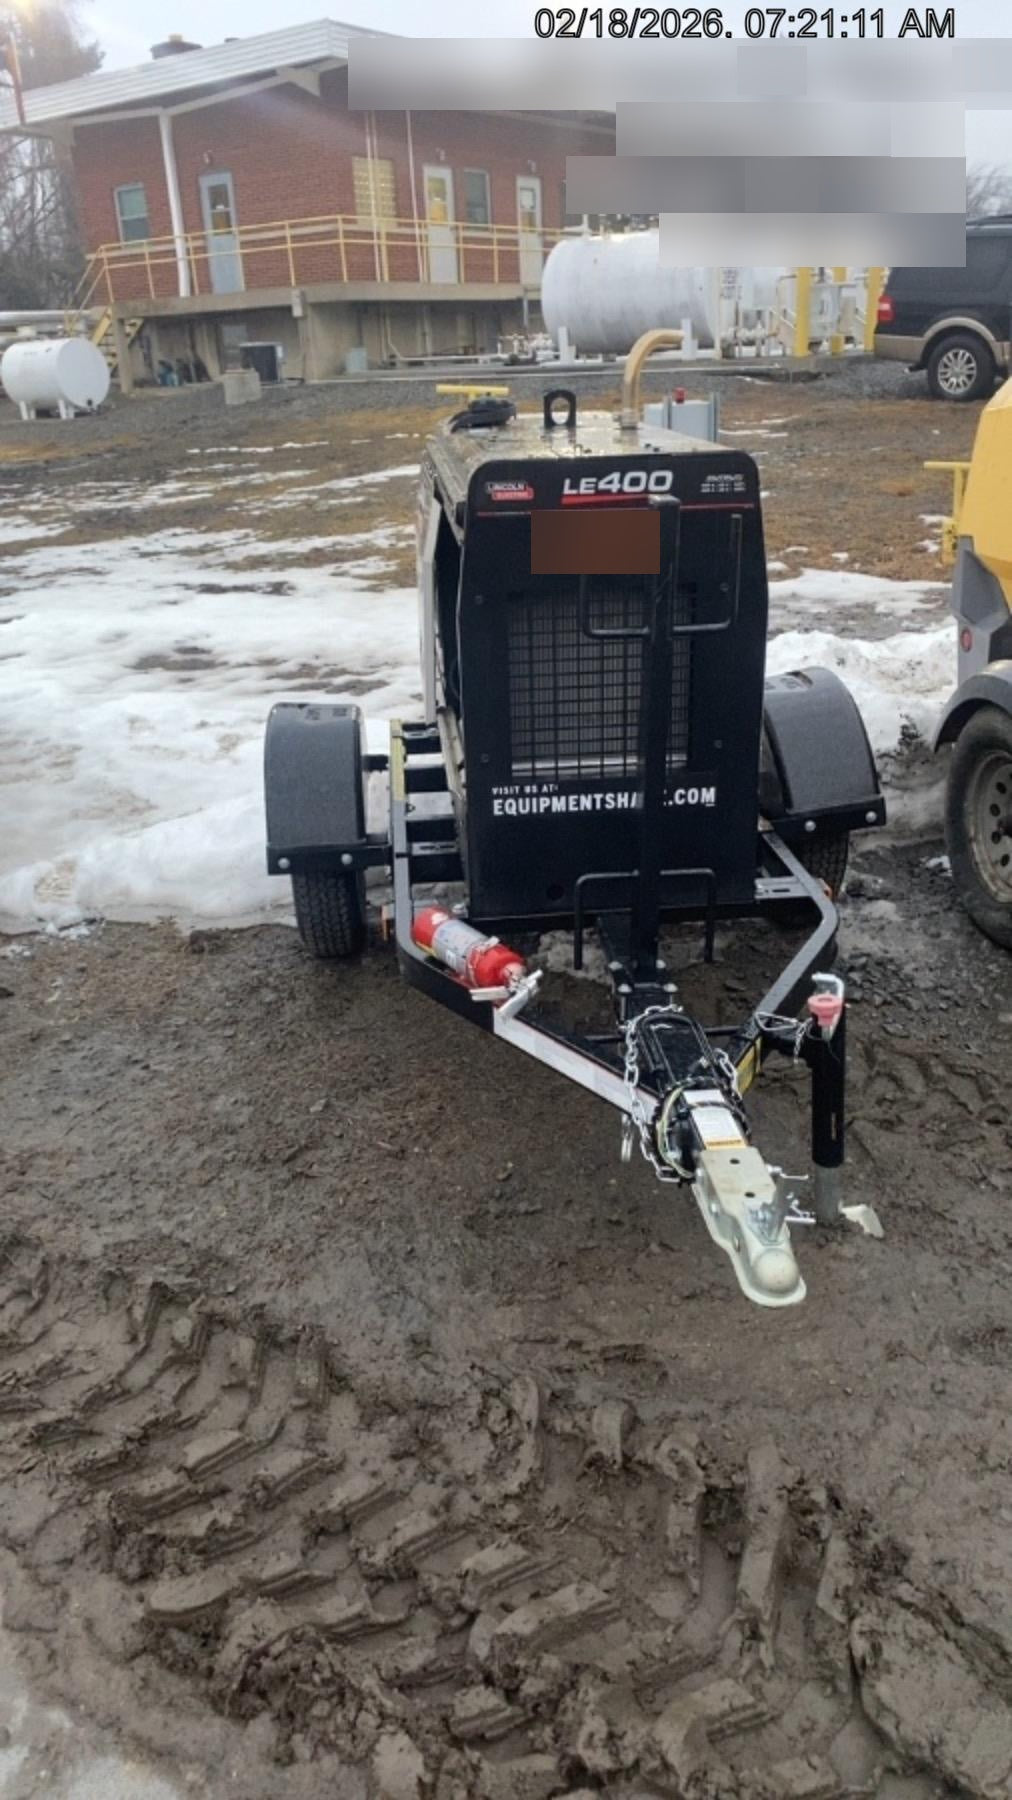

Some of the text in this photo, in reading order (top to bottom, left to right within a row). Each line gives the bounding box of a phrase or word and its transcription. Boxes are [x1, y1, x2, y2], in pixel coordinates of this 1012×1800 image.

[563, 470, 673, 495] LE400
[492, 785, 520, 795] VISIT
[493, 787, 716, 816] EQUIPMENTSH.COM
